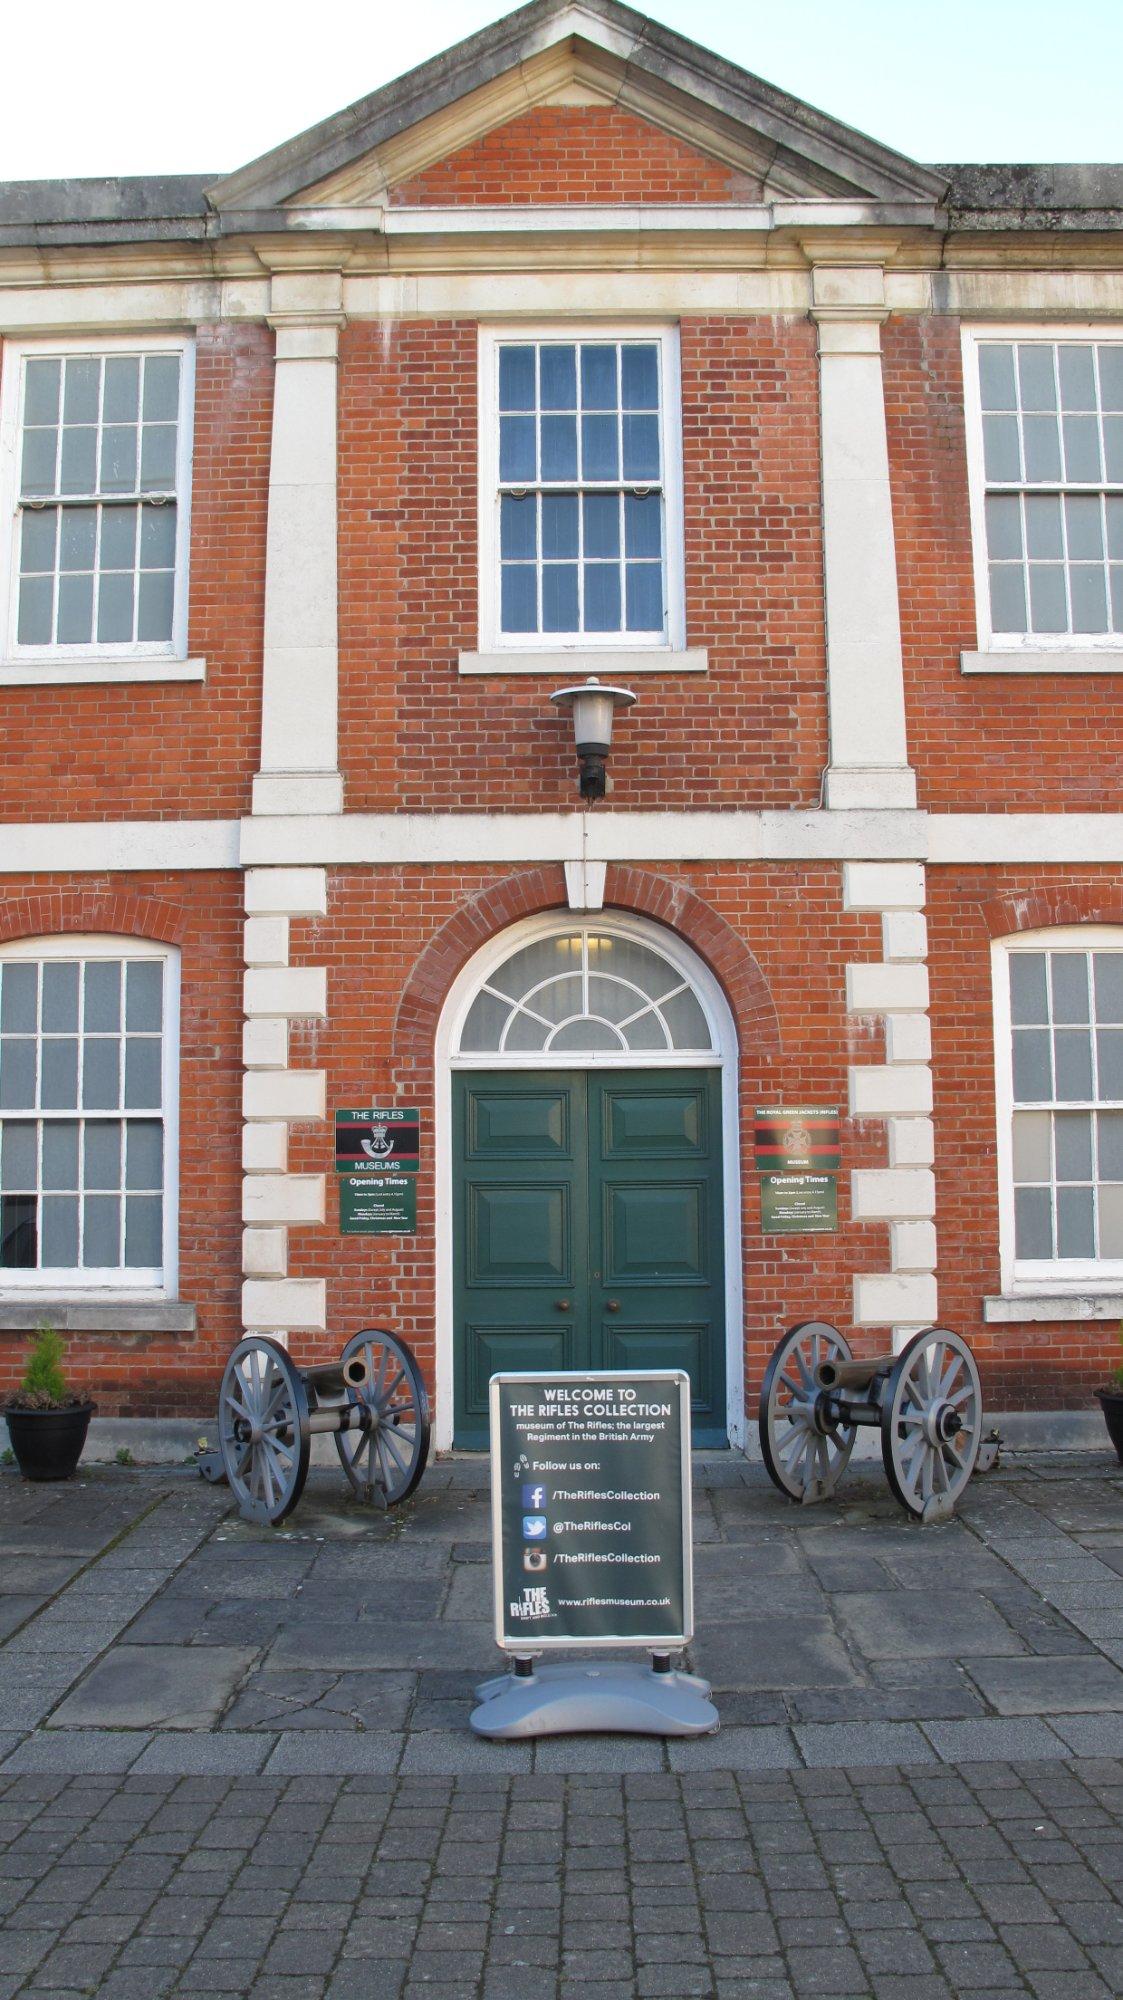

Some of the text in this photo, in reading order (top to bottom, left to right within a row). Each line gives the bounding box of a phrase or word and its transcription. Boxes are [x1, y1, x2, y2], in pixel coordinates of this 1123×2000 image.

[352, 1111, 404, 1120] THE RIFLES
[354, 1161, 400, 1170] MUSEUMS
[349, 1177, 408, 1187] Opening Times
[770, 1176, 804, 1185] Opening
[544, 1389, 636, 1401] WELCOME TO
[510, 1404, 671, 1417] THE RIFLES COLLECTION
[516, 1421, 665, 1431] museum of The Rifles; the largest
[527, 1433, 655, 1442] Regiment in the British Army
[532, 1461, 601, 1470] Follow us on:
[552, 1490, 660, 1501] /TheRiflesCollection
[553, 1521, 631, 1533] @TheRiflesCol
[553, 1552, 661, 1563] /TheRiflesCollection
[523, 1586, 546, 1601] THE
[510, 1596, 551, 1617] RIFLES
[558, 1597, 671, 1607] www.riflesmuseum.co.uk
